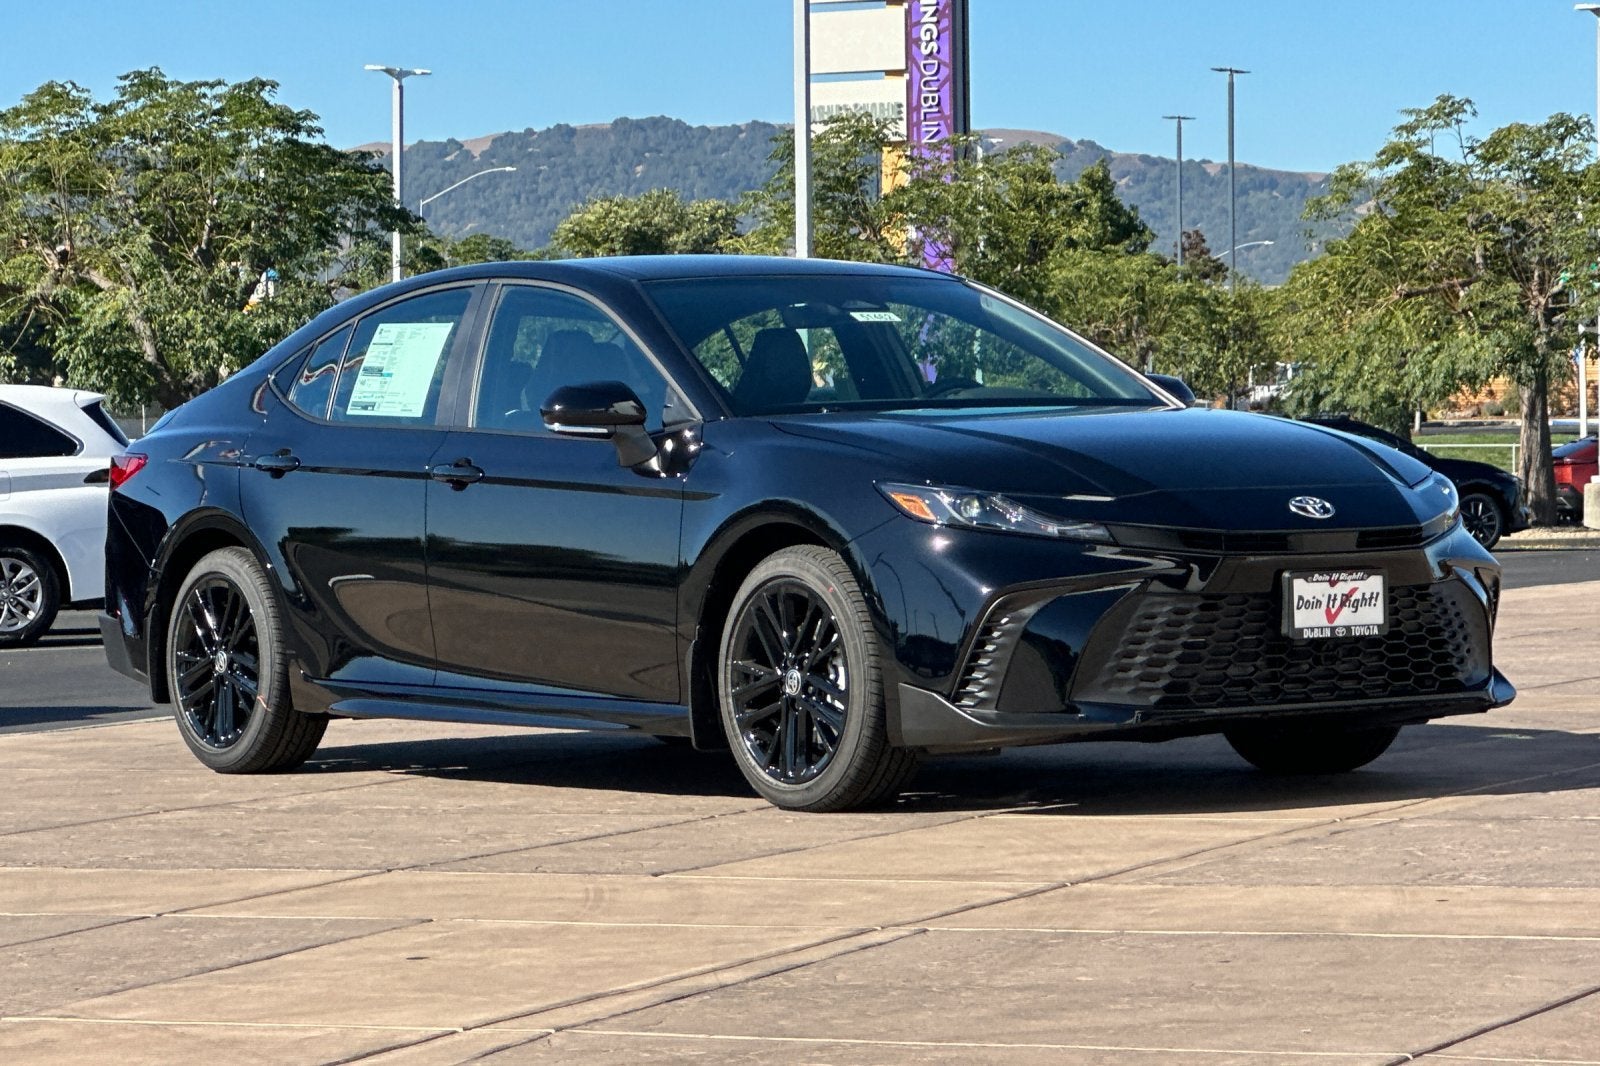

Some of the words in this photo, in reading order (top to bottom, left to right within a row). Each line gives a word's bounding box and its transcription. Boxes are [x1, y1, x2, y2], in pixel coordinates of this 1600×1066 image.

[920, 60, 939, 143] DUBLIN
[1296, 593, 1325, 610] Doin'
[1326, 593, 1338, 609] It
[1340, 592, 1380, 613] Right!
[1303, 628, 1331, 638] DUBLIN
[1351, 625, 1378, 636] TOYOTA
